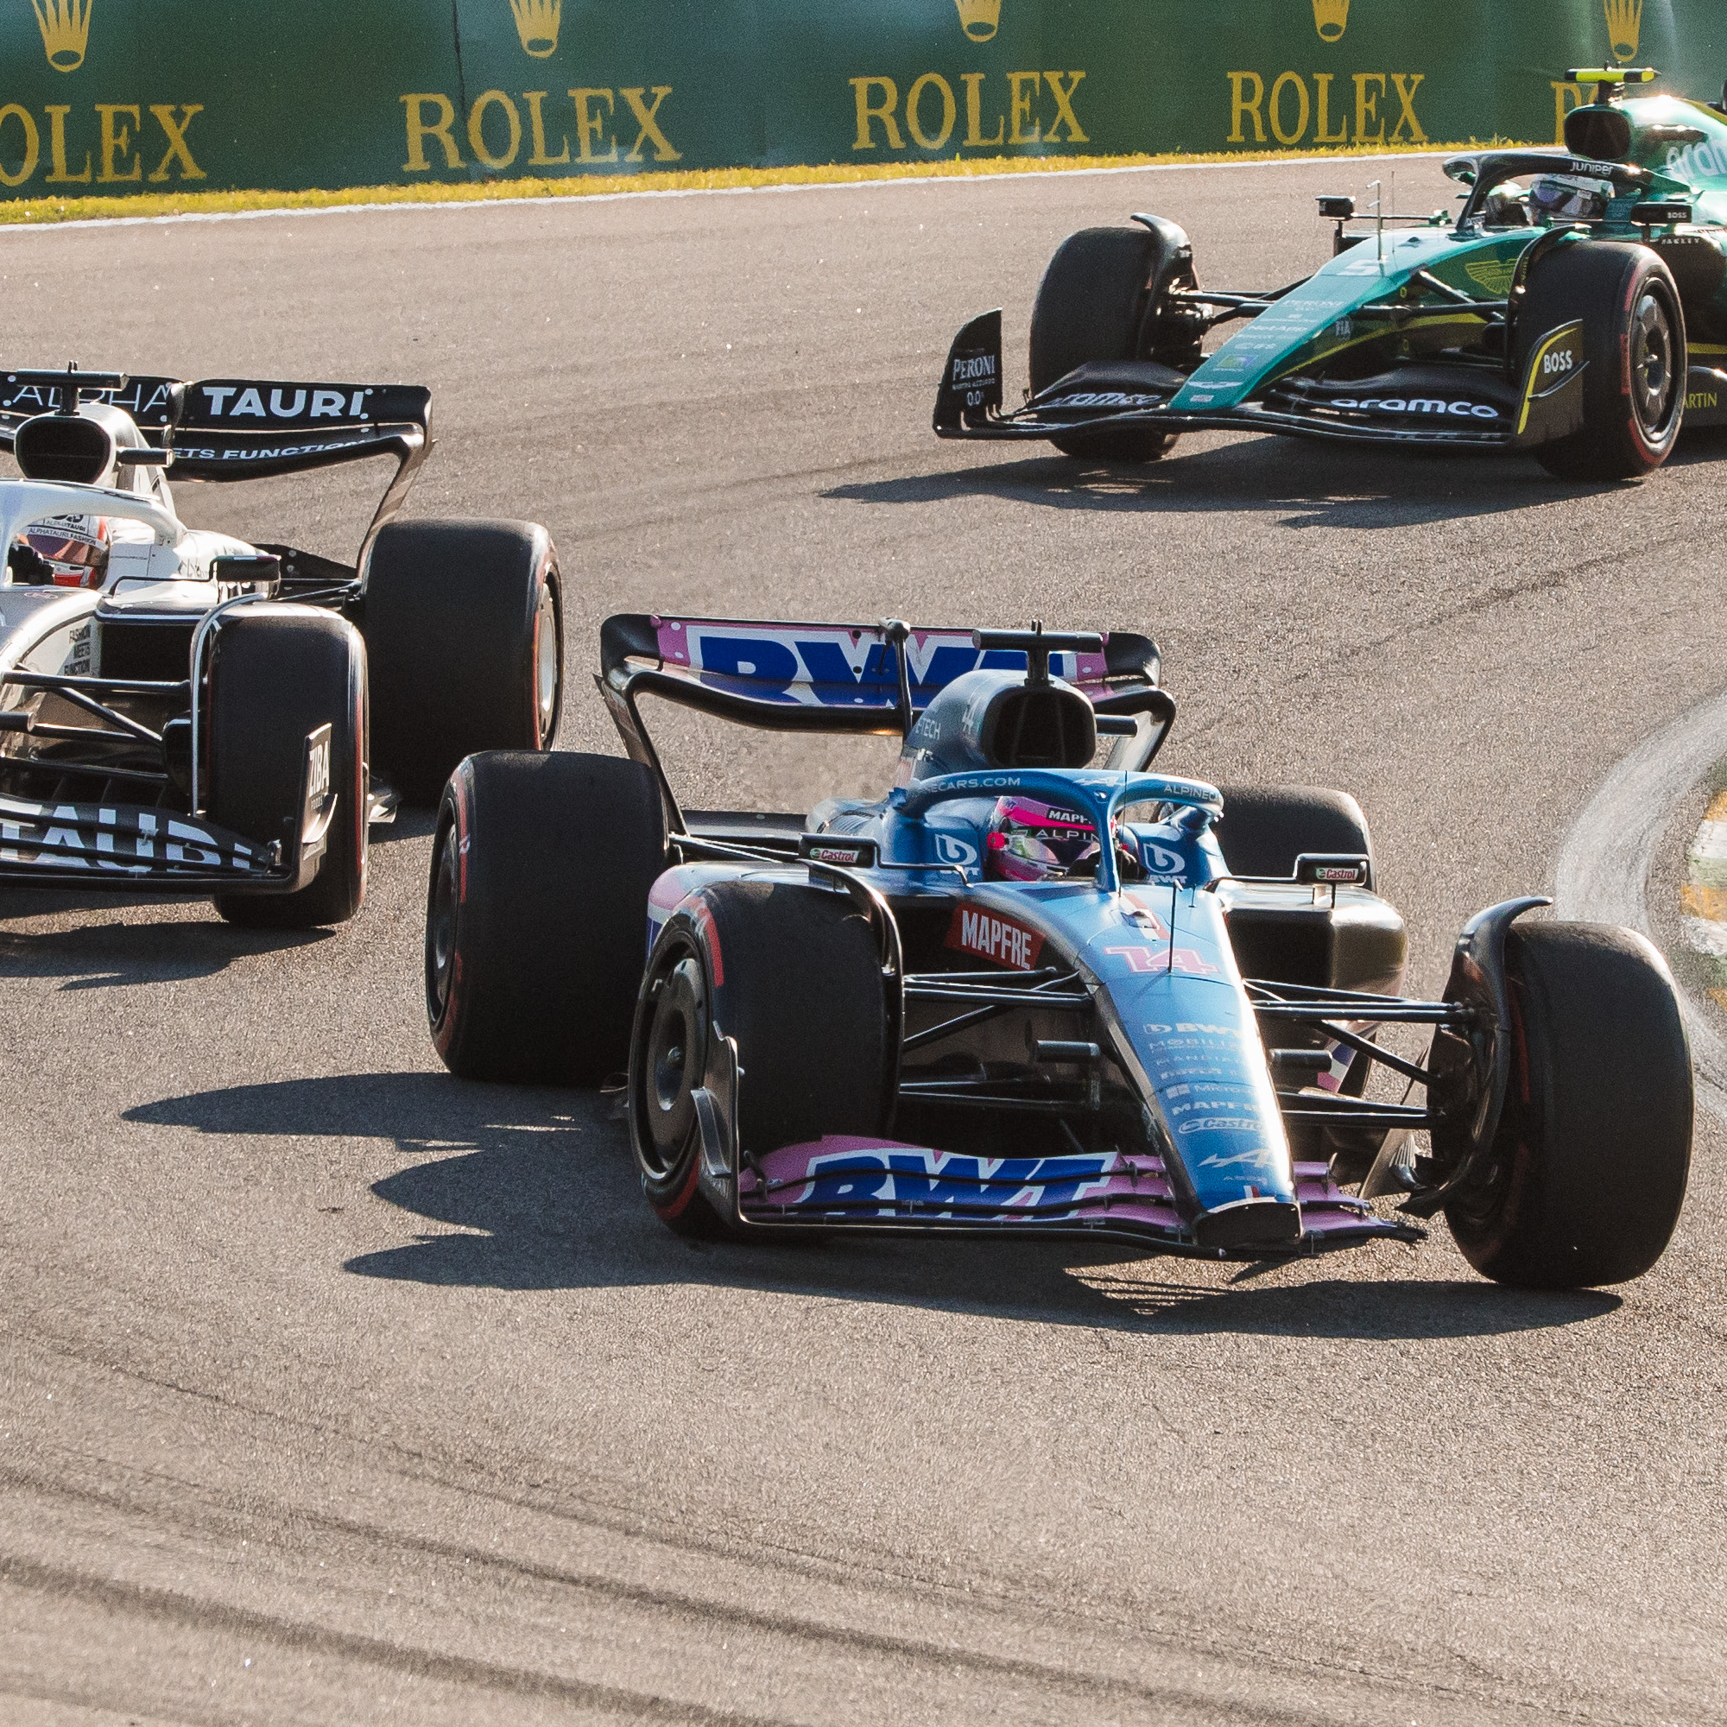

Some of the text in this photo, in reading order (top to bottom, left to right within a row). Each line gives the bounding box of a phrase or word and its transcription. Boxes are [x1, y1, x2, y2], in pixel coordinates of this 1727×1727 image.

[849, 70, 1089, 149] ROLEX
[1226, 70, 1429, 145] ROLEX
[399, 86, 681, 171] ROLEX
[953, 354, 995, 381] PERONI
[1544, 350, 1572, 373] BOSS
[203, 387, 364, 418] TAURI
[1331, 399, 1499, 418] aramco
[307, 740, 330, 798] ZIBA
[822, 850, 856, 862] Castrol
[1326, 869, 1356, 879] Castrol
[961, 910, 1031, 970] MAPFRE
[1103, 945, 1219, 975] 14
[797, 1149, 1119, 1219] BWT
